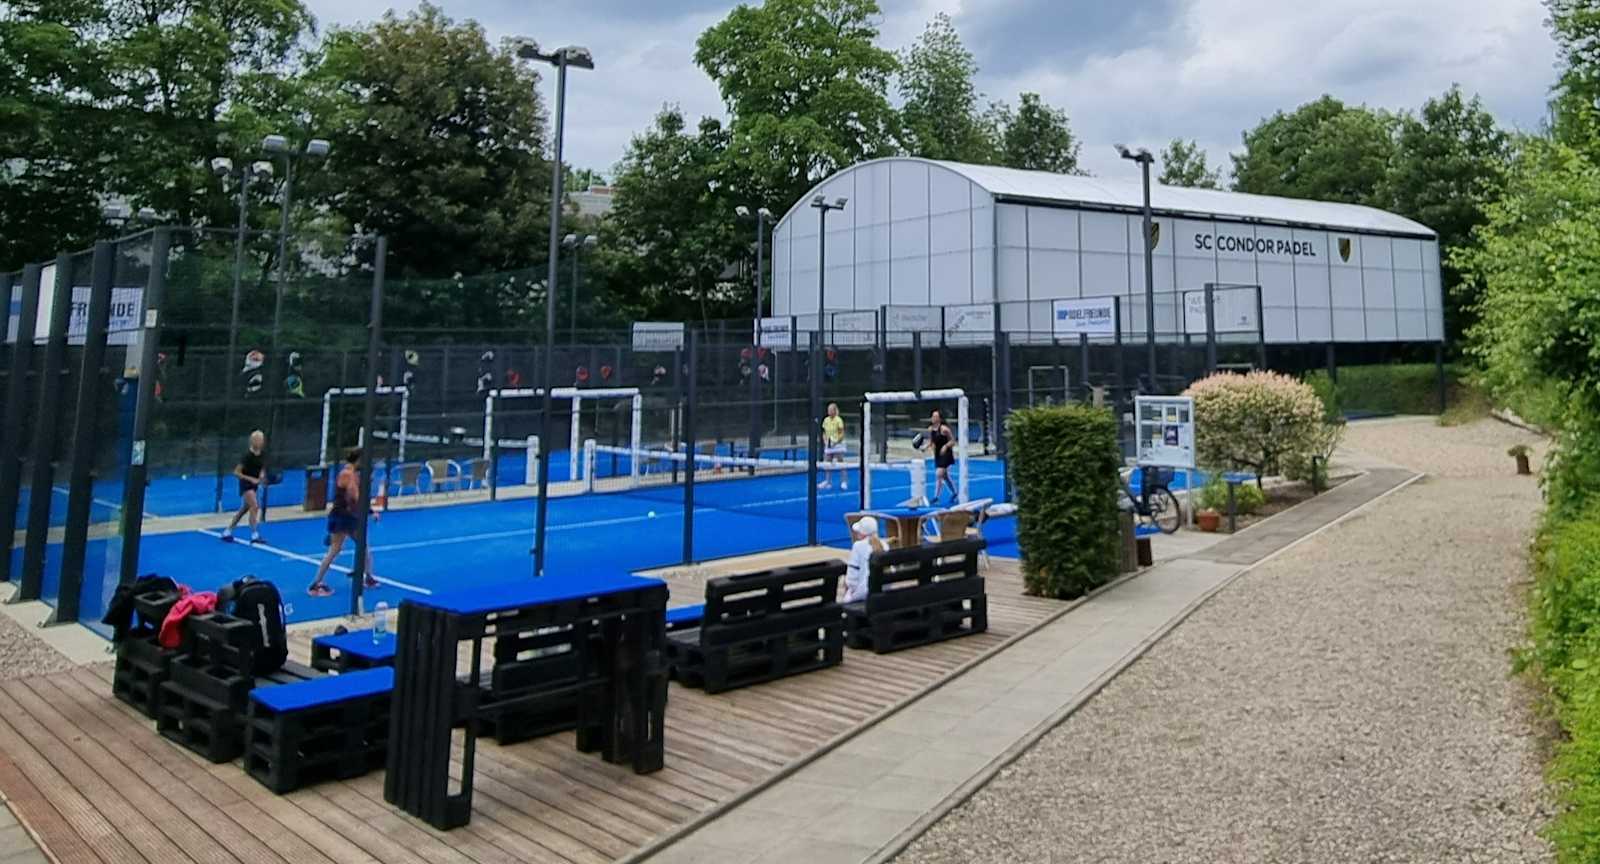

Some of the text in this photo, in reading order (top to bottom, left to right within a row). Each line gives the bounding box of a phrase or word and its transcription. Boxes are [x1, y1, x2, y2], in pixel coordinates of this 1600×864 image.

[1194, 234, 1316, 256] SC CONDOR PADEL
